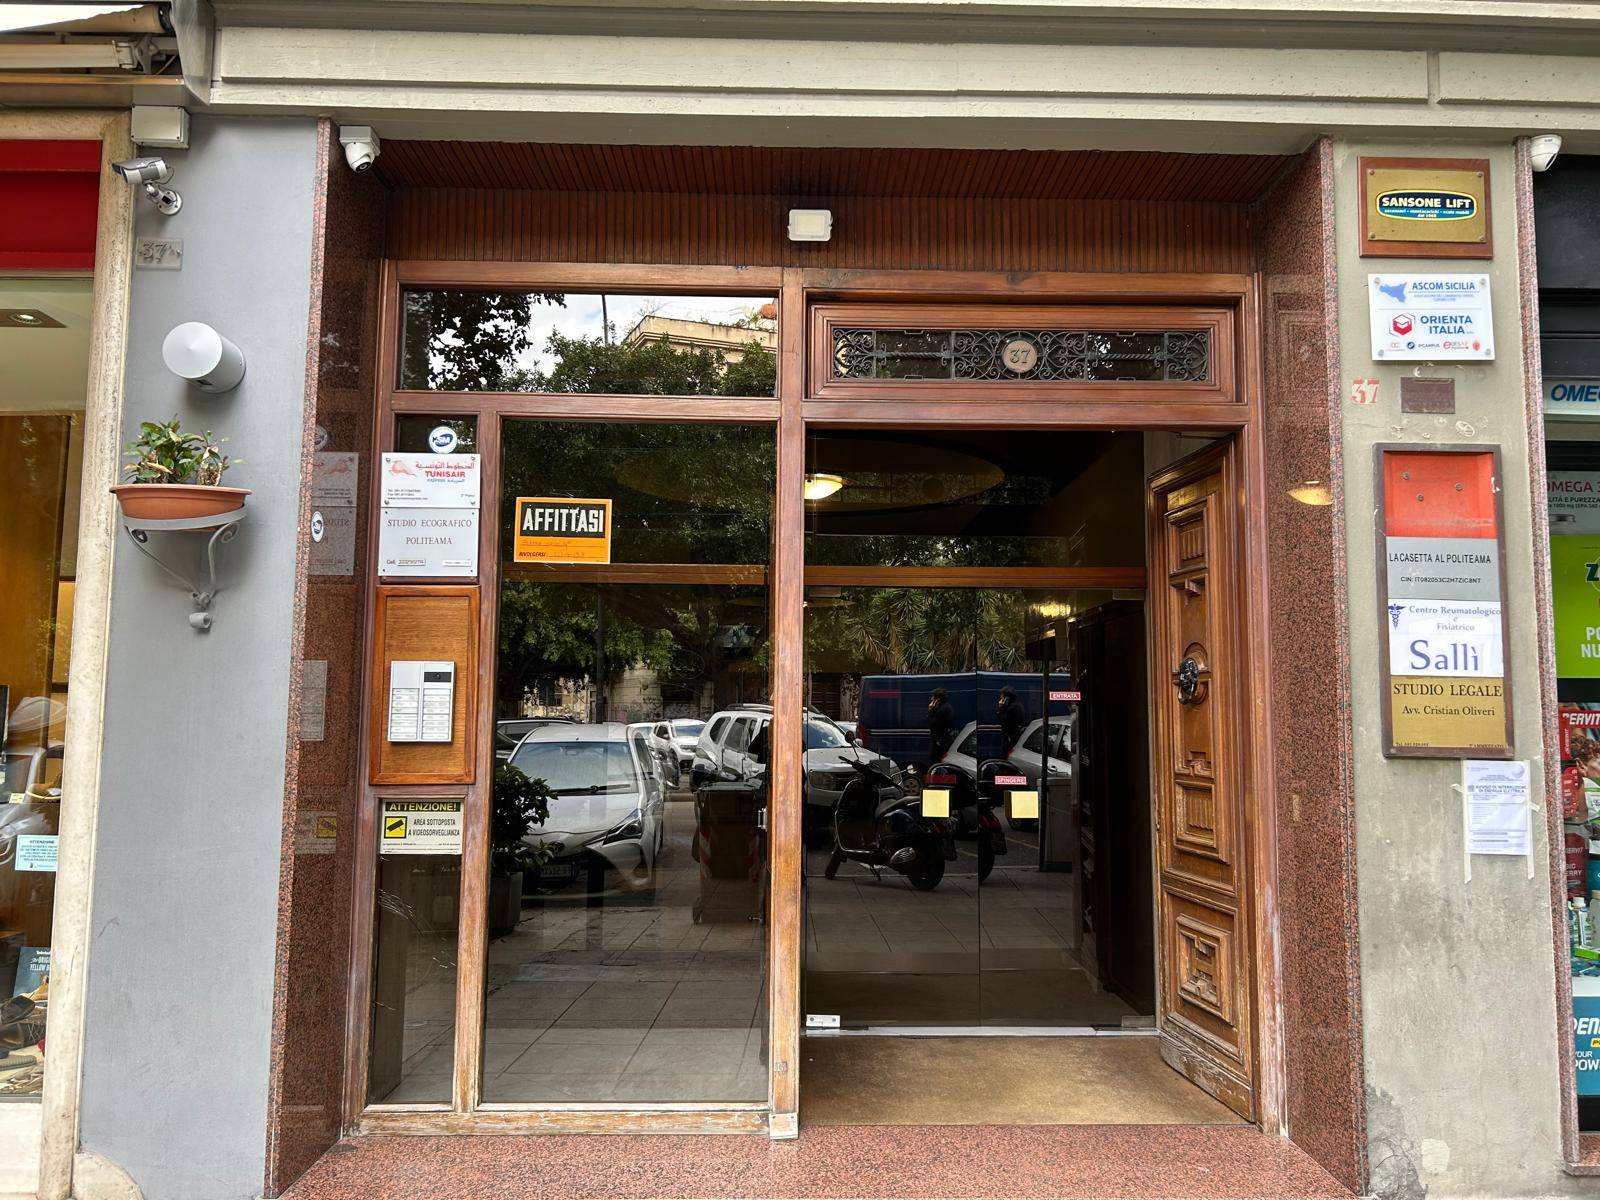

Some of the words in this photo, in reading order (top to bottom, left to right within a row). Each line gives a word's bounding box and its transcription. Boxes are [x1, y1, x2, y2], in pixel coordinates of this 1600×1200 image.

[1382, 197, 1441, 208] SANSONE
[1445, 198, 1471, 208] LIFT
[1412, 282, 1443, 290] ASCOM
[1445, 282, 1475, 290] SICILIA
[1420, 315, 1473, 324] ORIENTA
[1429, 325, 1465, 335] ITALIA
[1010, 349, 1031, 364] 37
[1351, 379, 1380, 404] 37
[1550, 384, 1600, 402] OME
[387, 519, 417, 527] STUDIO
[421, 519, 472, 528] ECOGRAFICO
[522, 507, 604, 533] AFFITTASI
[406, 537, 453, 545] POLITEAMA
[1389, 553, 1399, 562] LA
[1400, 553, 1433, 562] CASETTA
[1435, 553, 1445, 563] AL
[1446, 554, 1492, 564] POLITEAMA
[1409, 605, 1438, 614] Centro
[1440, 606, 1502, 617] Reumatologico
[1437, 622, 1475, 631] Fisiatrico
[1410, 639, 1479, 671] Sallì
[1393, 683, 1444, 696] STUDIO
[1450, 684, 1502, 697] LEGALE
[1402, 706, 1420, 714] Avv.
[1423, 705, 1460, 715] Cristian
[1462, 706, 1495, 716] Oliveri
[390, 803, 457, 811] ATTENZIONE!
